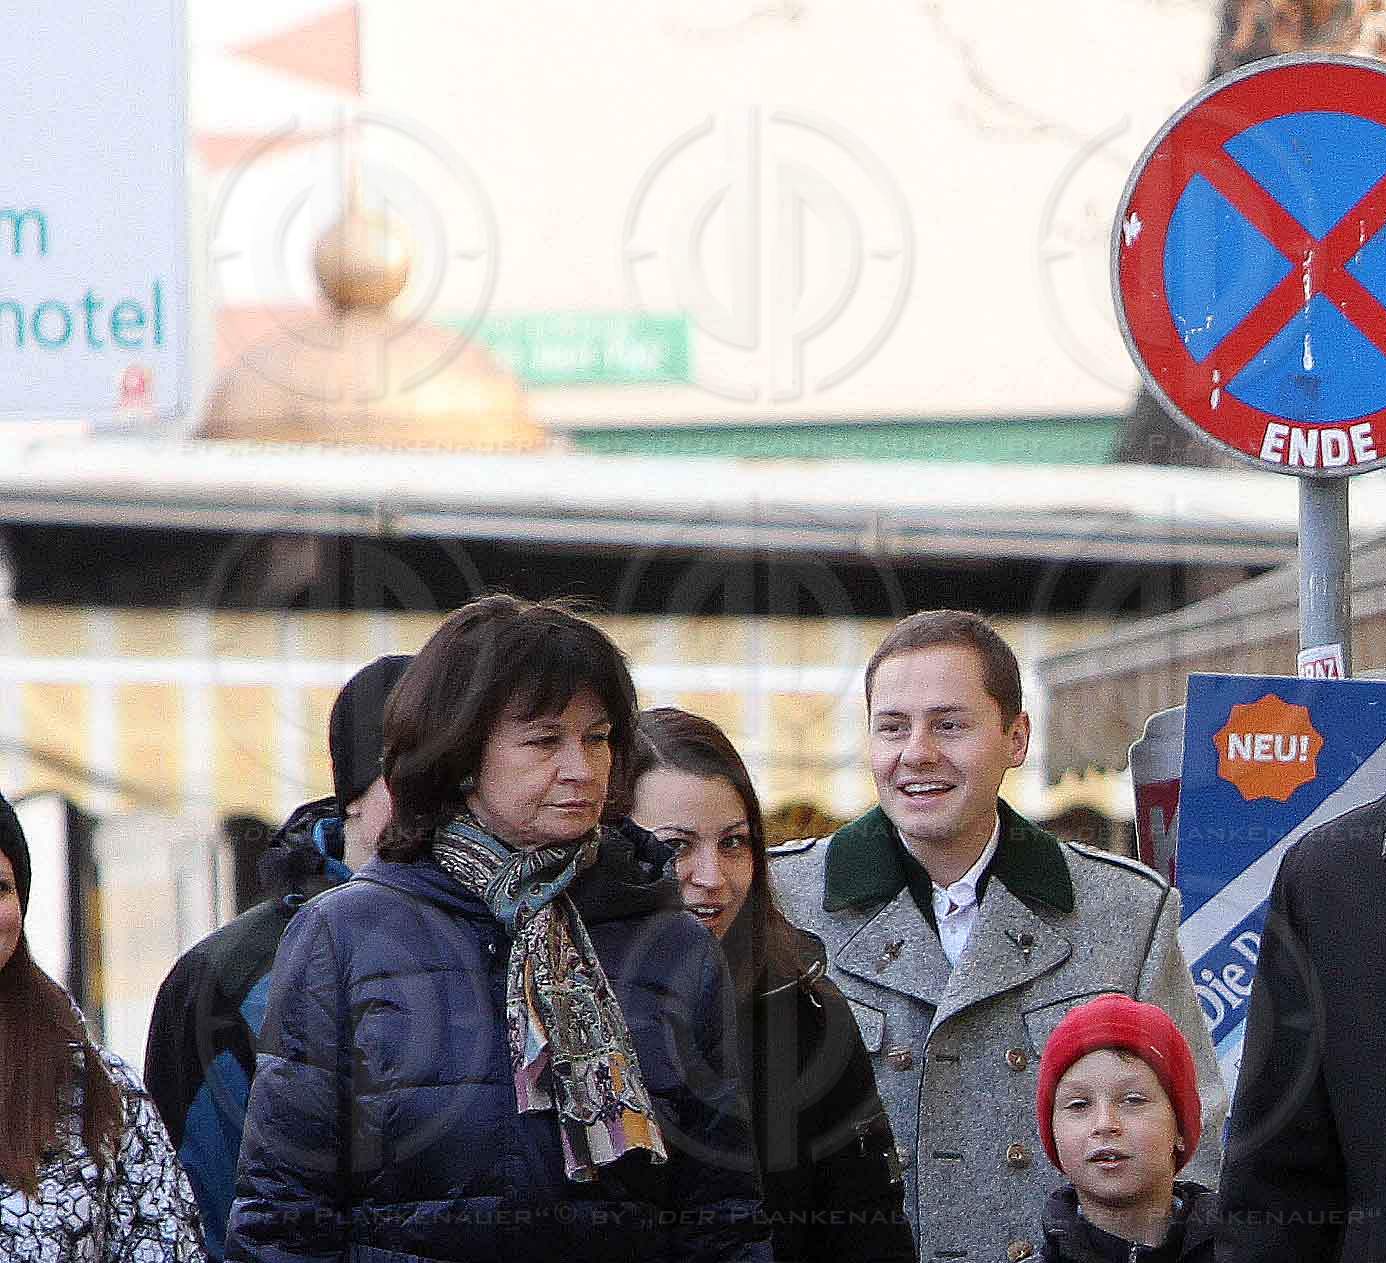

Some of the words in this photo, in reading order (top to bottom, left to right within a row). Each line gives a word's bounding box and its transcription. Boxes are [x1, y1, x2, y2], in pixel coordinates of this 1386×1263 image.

[1259, 421, 1379, 469] ENDE
[1227, 732, 1310, 763] NEU!
[1195, 963, 1252, 1033] Die
